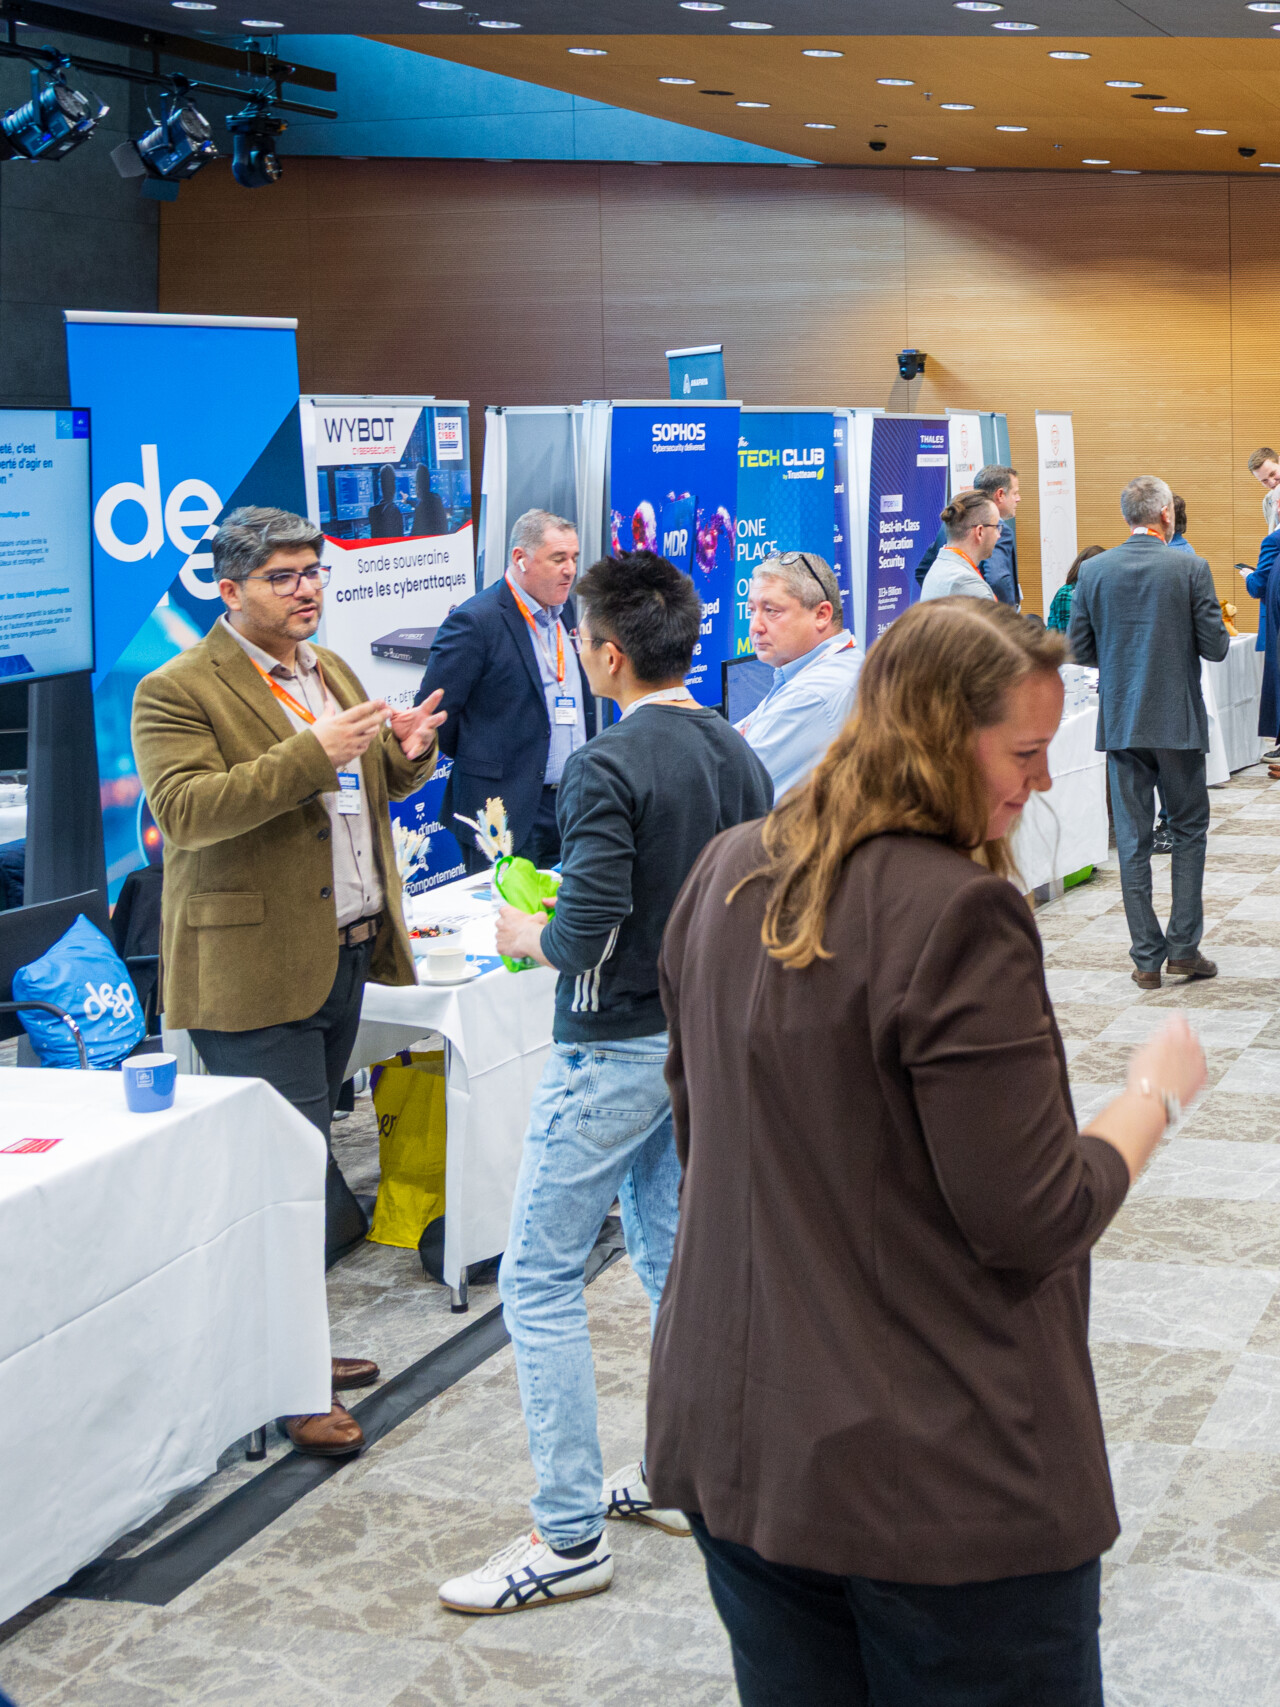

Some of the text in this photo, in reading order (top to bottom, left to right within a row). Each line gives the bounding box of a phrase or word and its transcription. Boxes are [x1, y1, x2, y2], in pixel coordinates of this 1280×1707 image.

[324, 418, 394, 443] WYBOT
[652, 423, 706, 441] SOPHOS
[920, 434, 944, 444] THALES
[737, 448, 825, 468] TECH CLUB
[737, 518, 766, 538] ONE
[663, 528, 688, 558] MDR
[879, 536, 914, 554] Application
[358, 549, 450, 574] Sonde souveraine
[879, 554, 905, 570] Security
[336, 572, 466, 603] contre les cyberattaques
